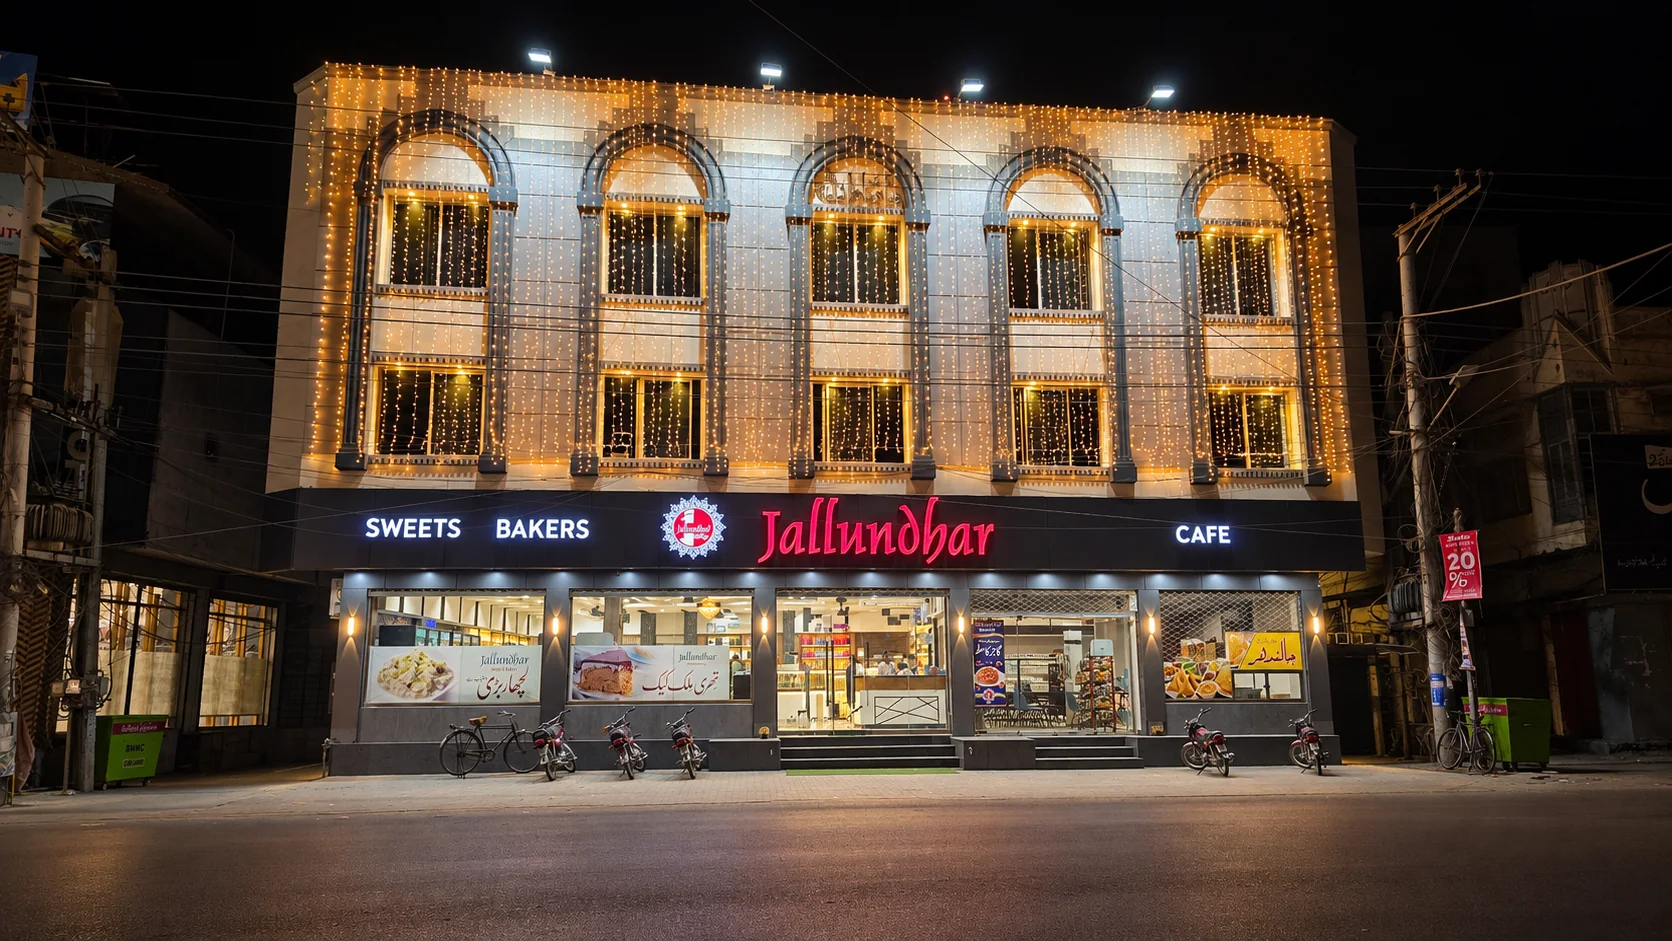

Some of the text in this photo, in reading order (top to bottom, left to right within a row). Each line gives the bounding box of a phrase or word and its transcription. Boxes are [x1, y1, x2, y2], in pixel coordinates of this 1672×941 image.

[365, 518, 590, 539] SWEETS BAKERS
[758, 497, 994, 563] Jallundhar
[1175, 525, 1231, 544] CAFE
[1447, 551, 1475, 571] 20
[1449, 571, 1468, 589] %
[480, 652, 529, 667] Jallundhar
